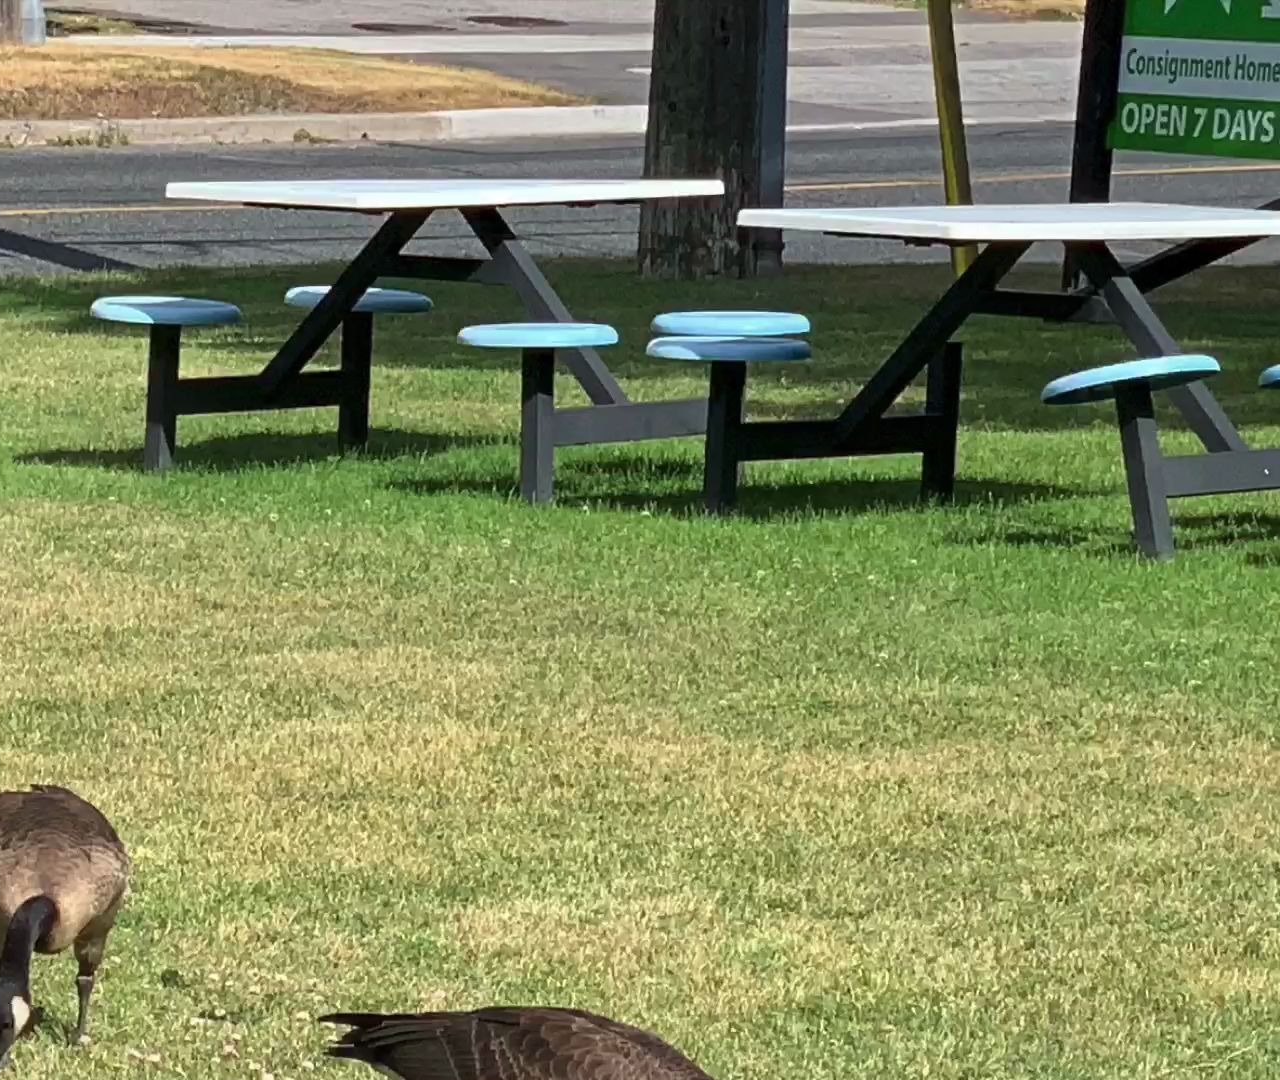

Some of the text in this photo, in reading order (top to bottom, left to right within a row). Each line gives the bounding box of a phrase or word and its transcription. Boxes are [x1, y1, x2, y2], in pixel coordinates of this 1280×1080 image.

[1126, 48, 1280, 84] Consignment Home
[1121, 102, 1276, 143] OPEN 7 DAYS
